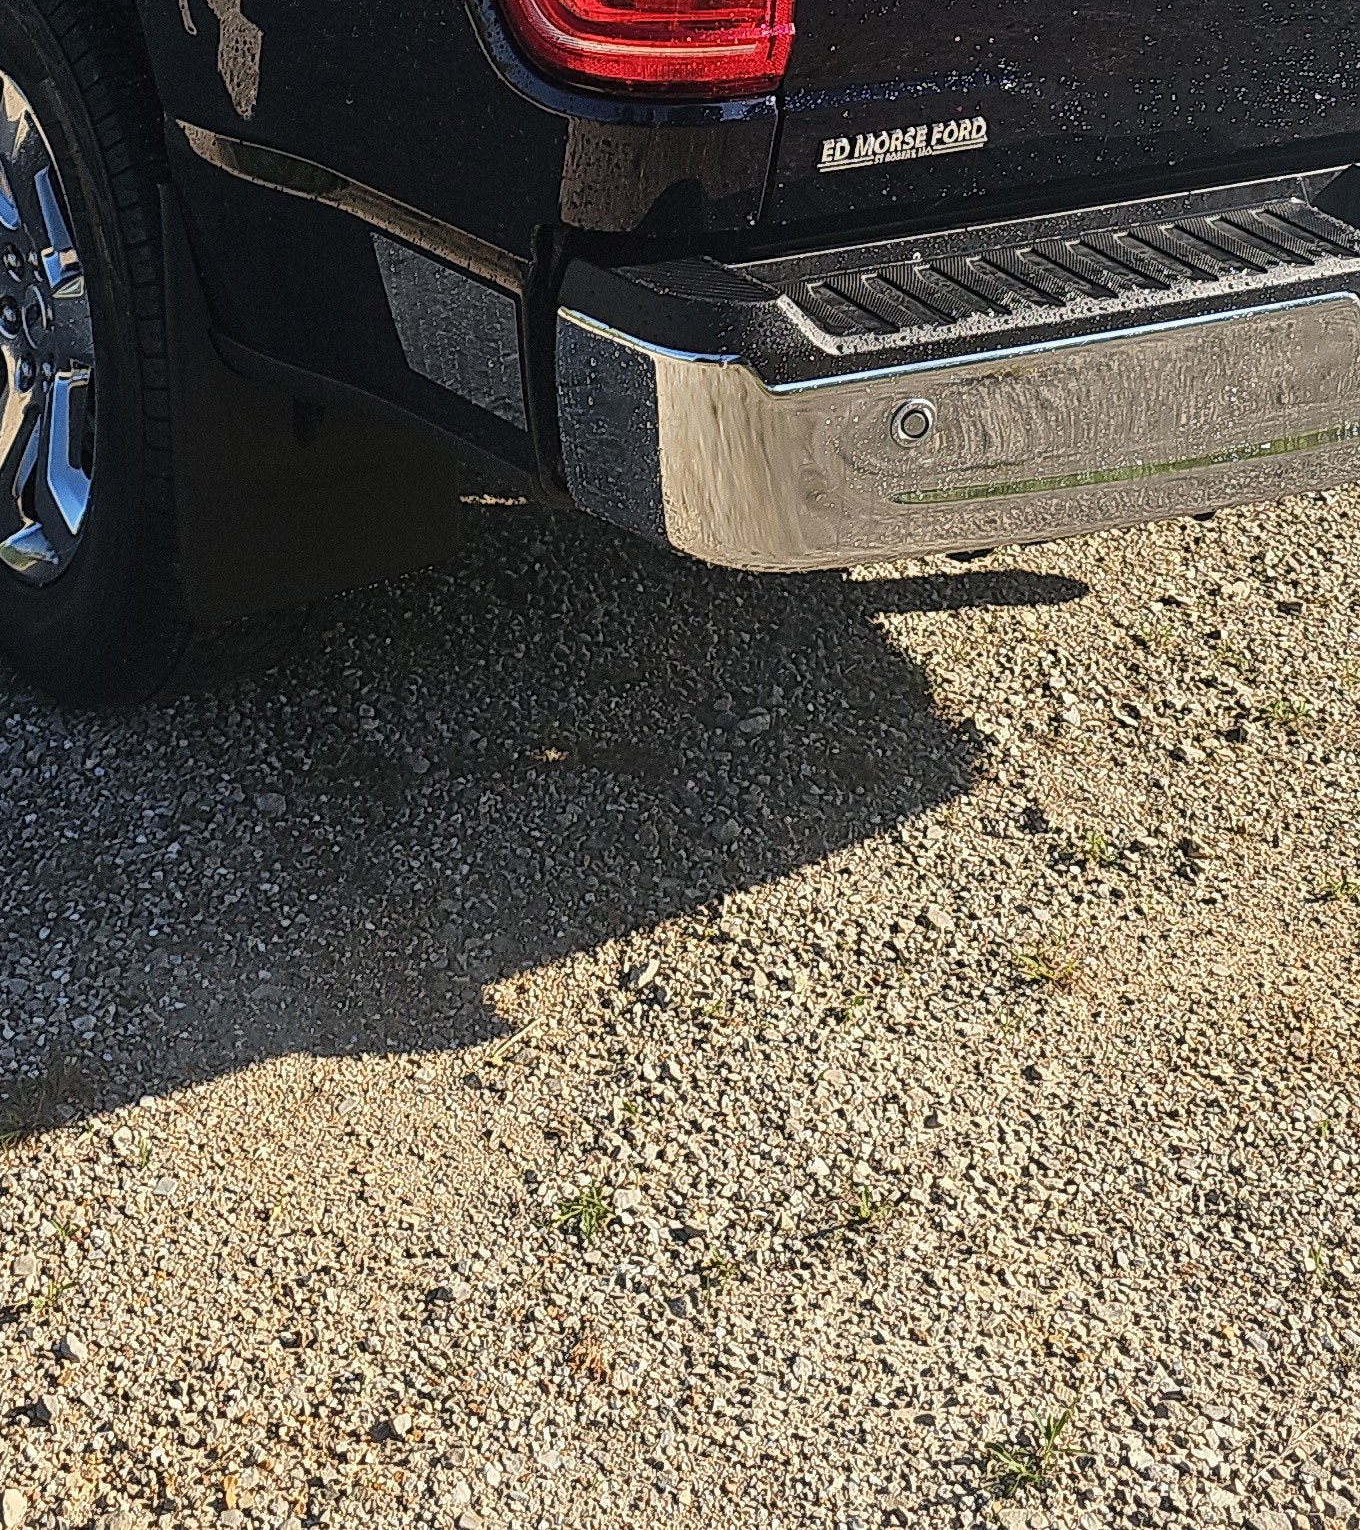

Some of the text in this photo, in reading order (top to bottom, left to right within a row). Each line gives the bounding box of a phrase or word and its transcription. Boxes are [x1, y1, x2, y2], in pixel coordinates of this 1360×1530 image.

[821, 115, 988, 162] ED MORSE FORD
